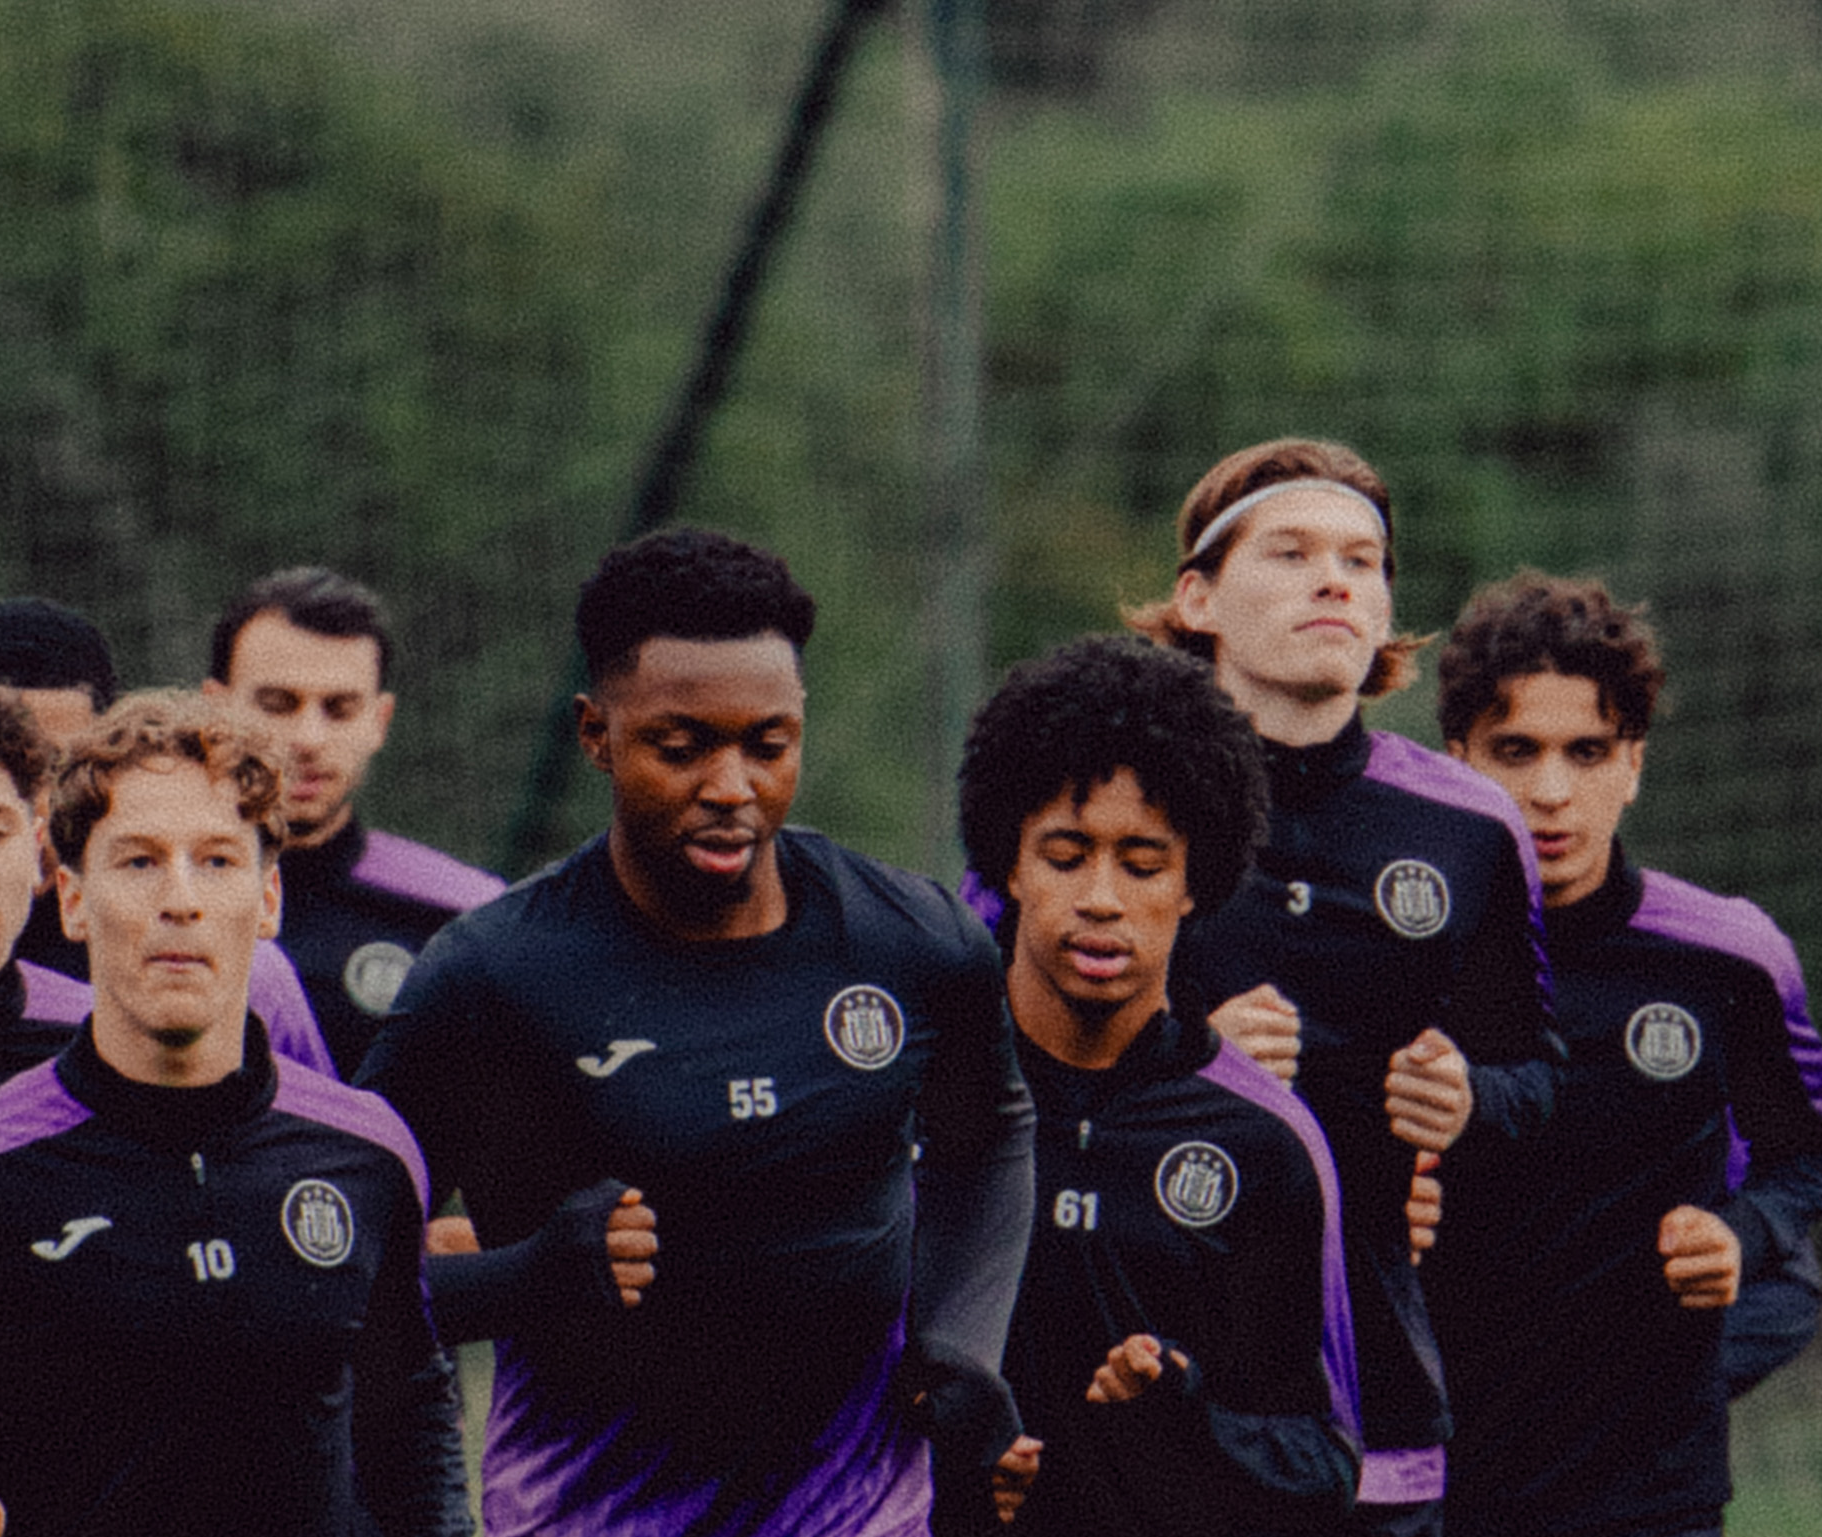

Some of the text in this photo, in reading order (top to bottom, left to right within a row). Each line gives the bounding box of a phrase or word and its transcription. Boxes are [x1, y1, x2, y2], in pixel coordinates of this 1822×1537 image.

[1287, 881, 1310, 915] 3
[729, 1077, 777, 1120] 55
[1054, 1189, 1099, 1230] 61
[186, 1239, 236, 1282] 10
